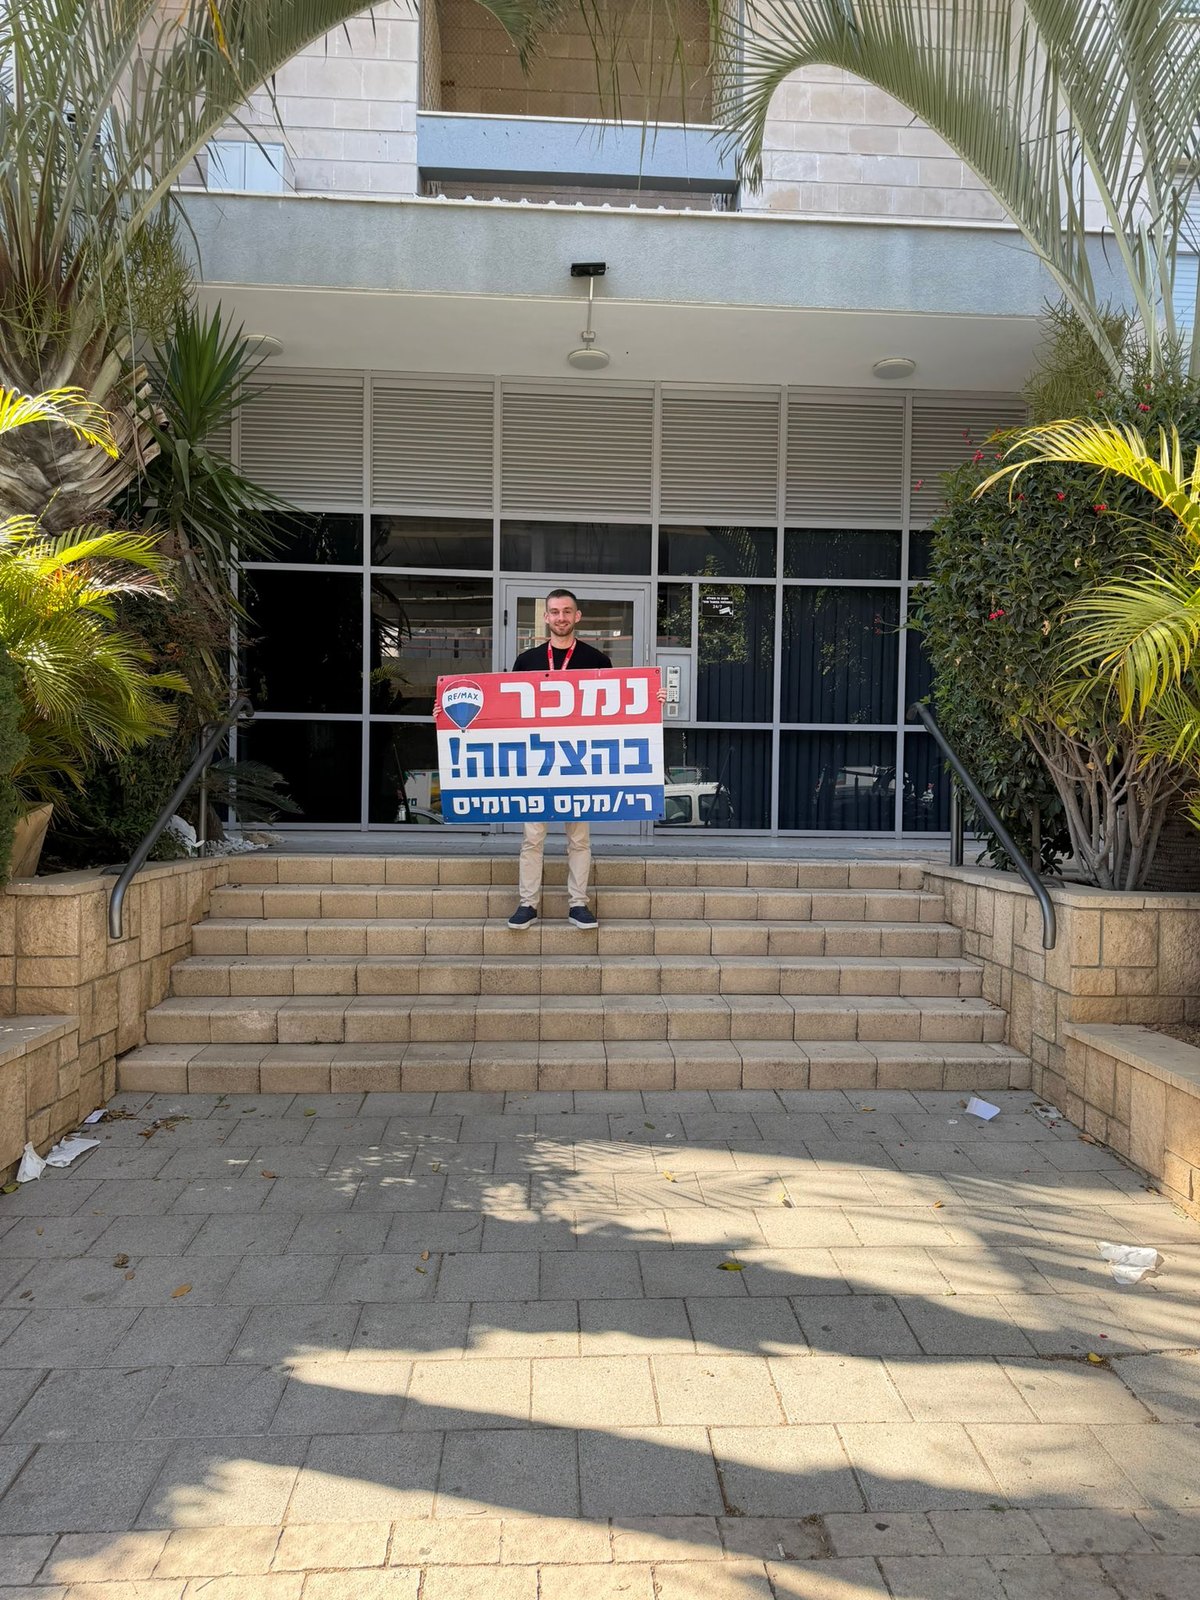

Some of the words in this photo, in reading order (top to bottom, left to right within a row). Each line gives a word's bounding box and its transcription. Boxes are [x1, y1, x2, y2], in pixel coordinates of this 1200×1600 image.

[447, 692, 479, 701] RE/MAX
[500, 677, 649, 719] נמכר
[449, 733, 653, 778] בהצלחה!
[452, 795, 545, 815] פרומיס
[553, 791, 653, 818] רי/מקס
